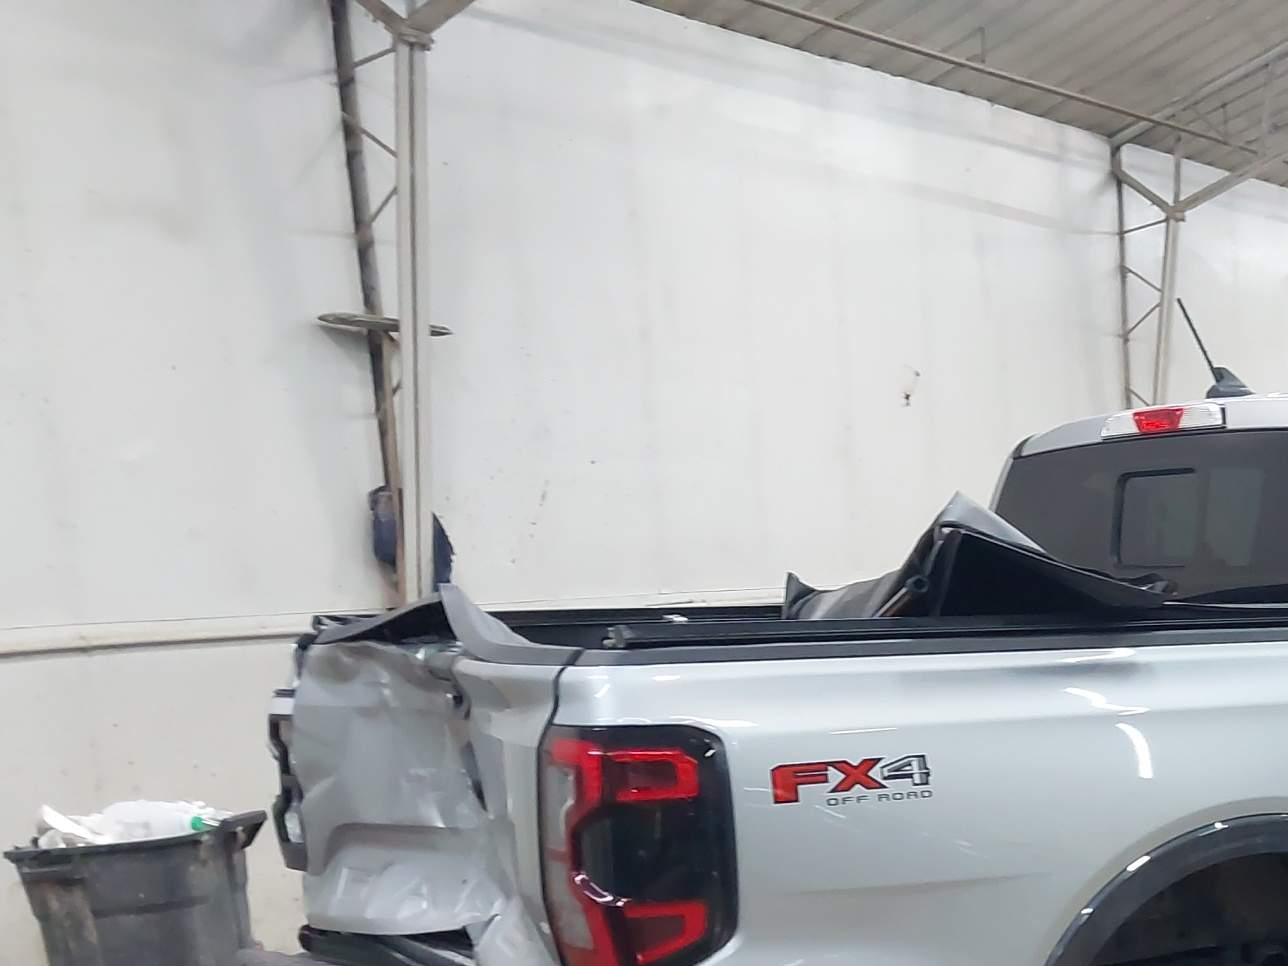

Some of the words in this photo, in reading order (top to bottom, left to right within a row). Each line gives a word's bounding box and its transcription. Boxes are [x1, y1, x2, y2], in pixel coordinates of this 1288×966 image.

[770, 753, 931, 805] FX4
[826, 794, 872, 807] OFF
[878, 790, 933, 803] ROAD
